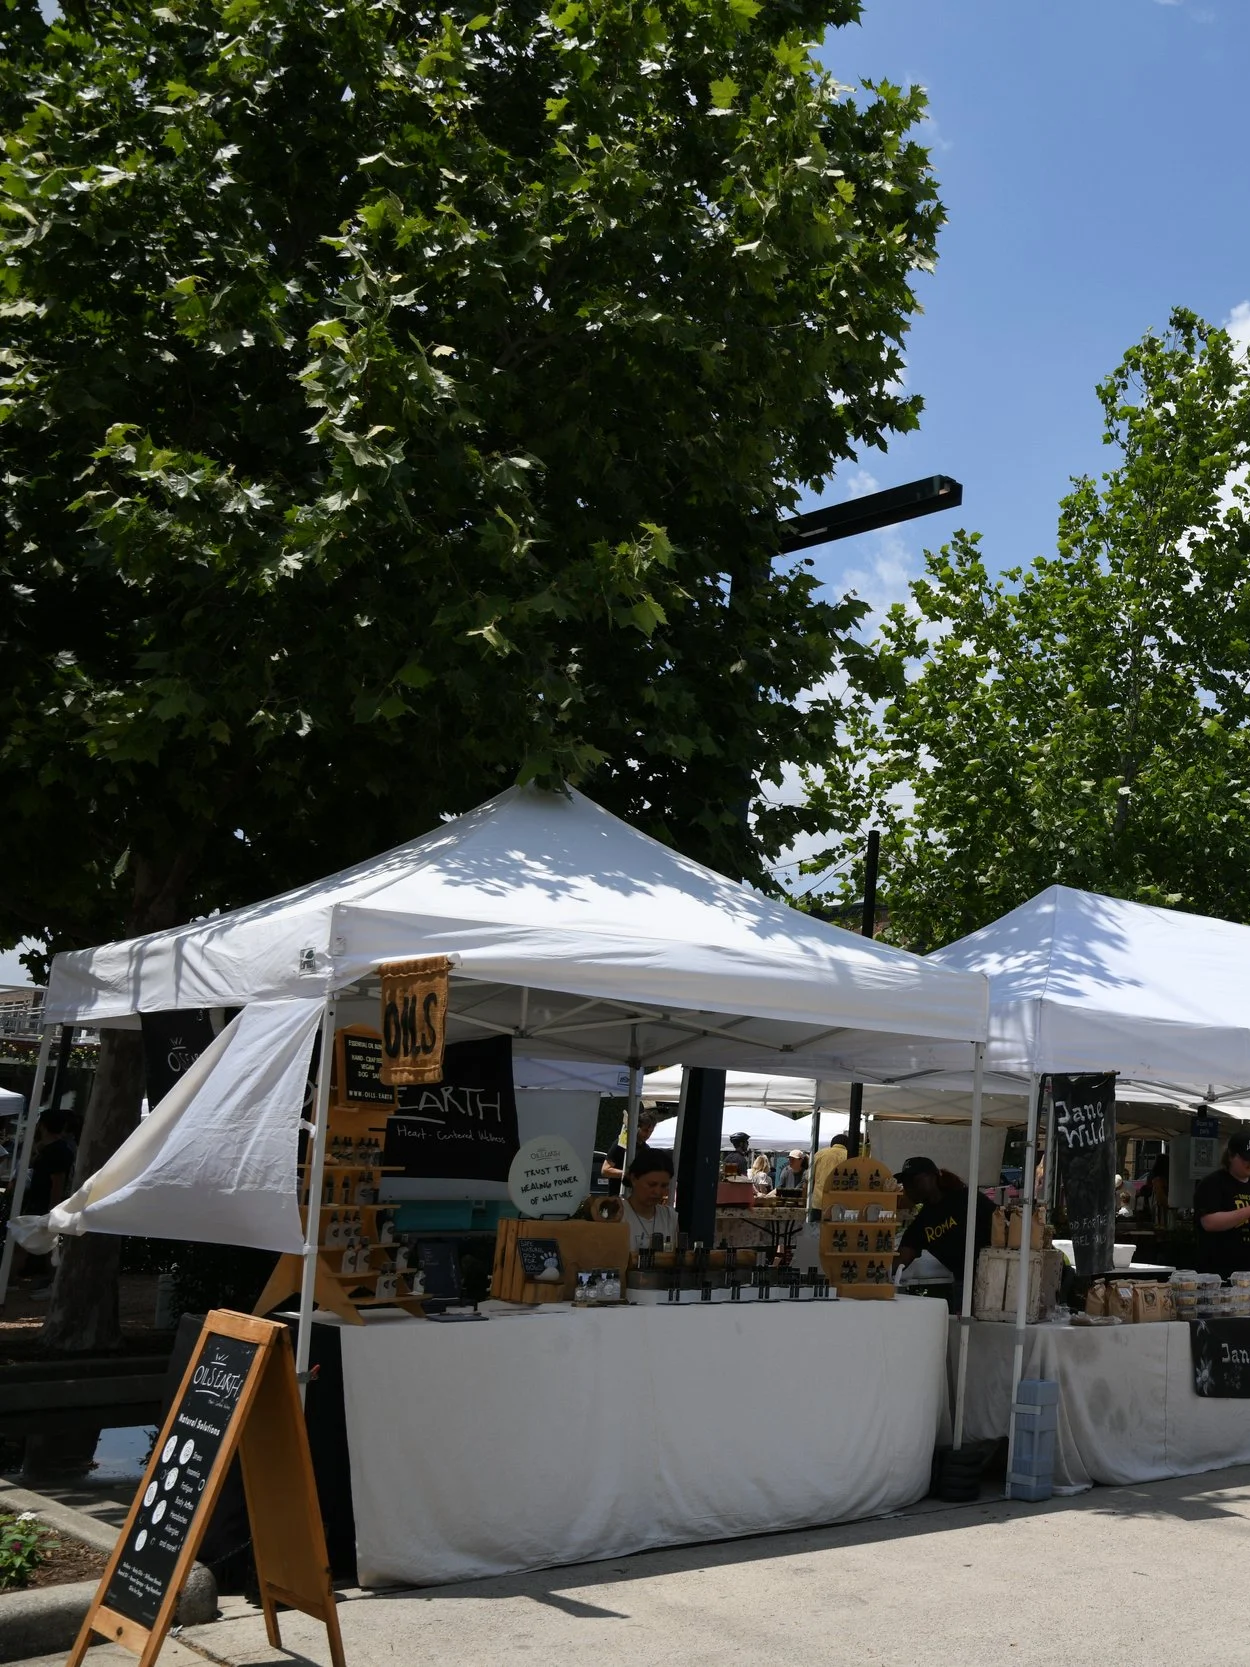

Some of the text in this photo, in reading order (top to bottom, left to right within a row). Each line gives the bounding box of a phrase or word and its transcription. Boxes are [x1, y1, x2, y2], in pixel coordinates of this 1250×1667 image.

[384, 992, 437, 1059] OILS
[1055, 1101, 1104, 1124] Jane
[1058, 1118, 1105, 1149] Wild
[524, 1163, 570, 1178] TRUST THE
[521, 1176, 579, 1193] HEALING POWER
[530, 1190, 573, 1205] OF NATURE
[178, 1413, 221, 1436] Natural Solutions
[181, 1481, 194, 1494] Fatigue
[174, 1495, 185, 1508] Body
[170, 1510, 188, 1525] Headaches
[164, 1524, 180, 1537] Allergies
